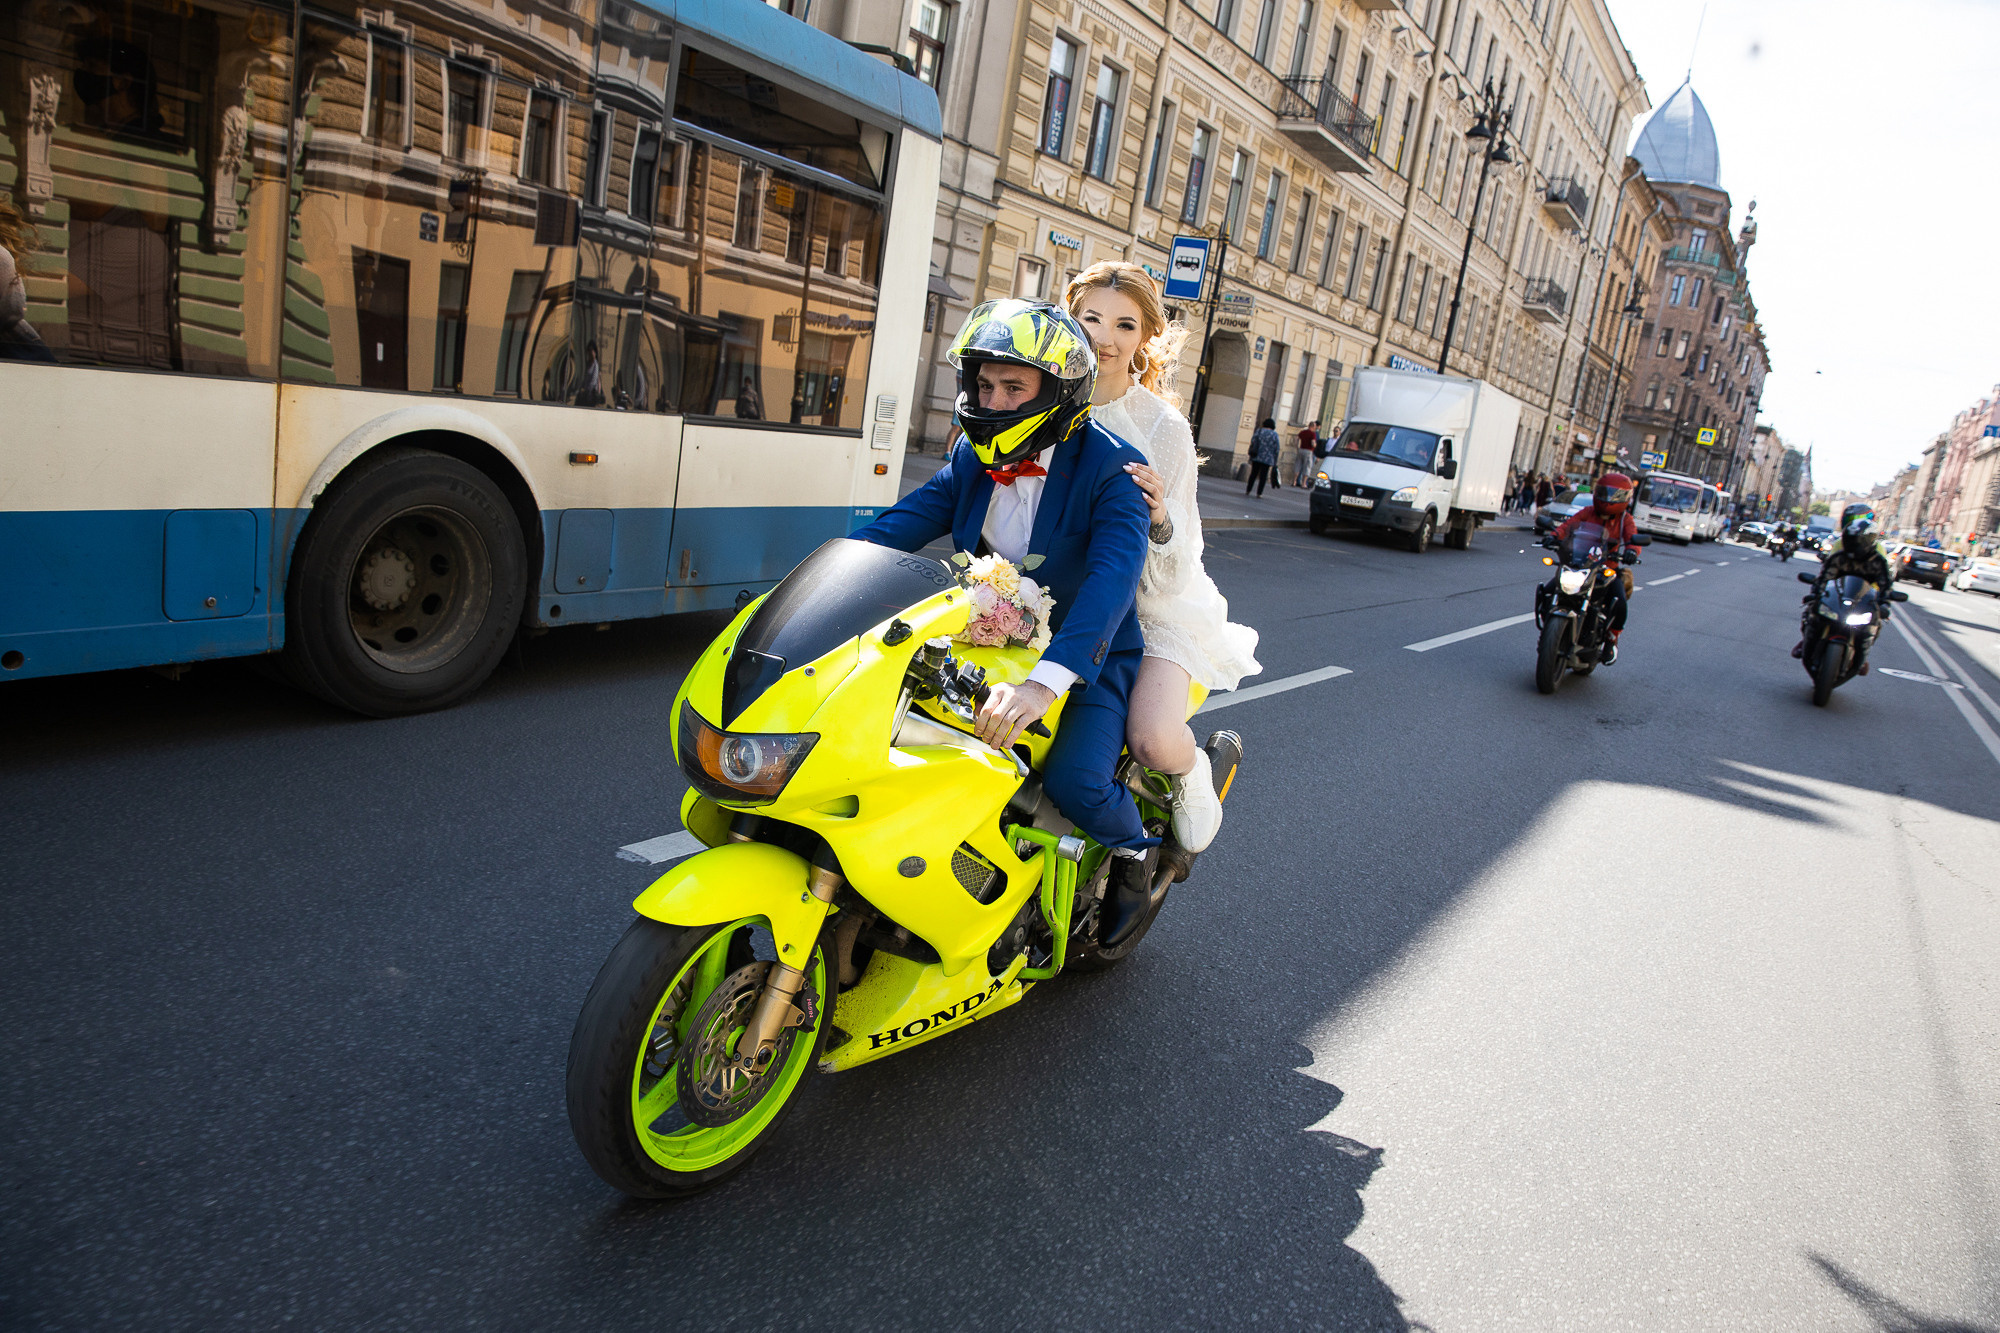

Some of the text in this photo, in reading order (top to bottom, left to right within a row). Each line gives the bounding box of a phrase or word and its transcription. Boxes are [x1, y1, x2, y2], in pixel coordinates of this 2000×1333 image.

[1047, 110, 1062, 155] КОМНАТЫ
[1051, 230, 1082, 251] красота
[1217, 317, 1249, 329] КЛЮЧИ
[867, 978, 1005, 1050] HONDA
